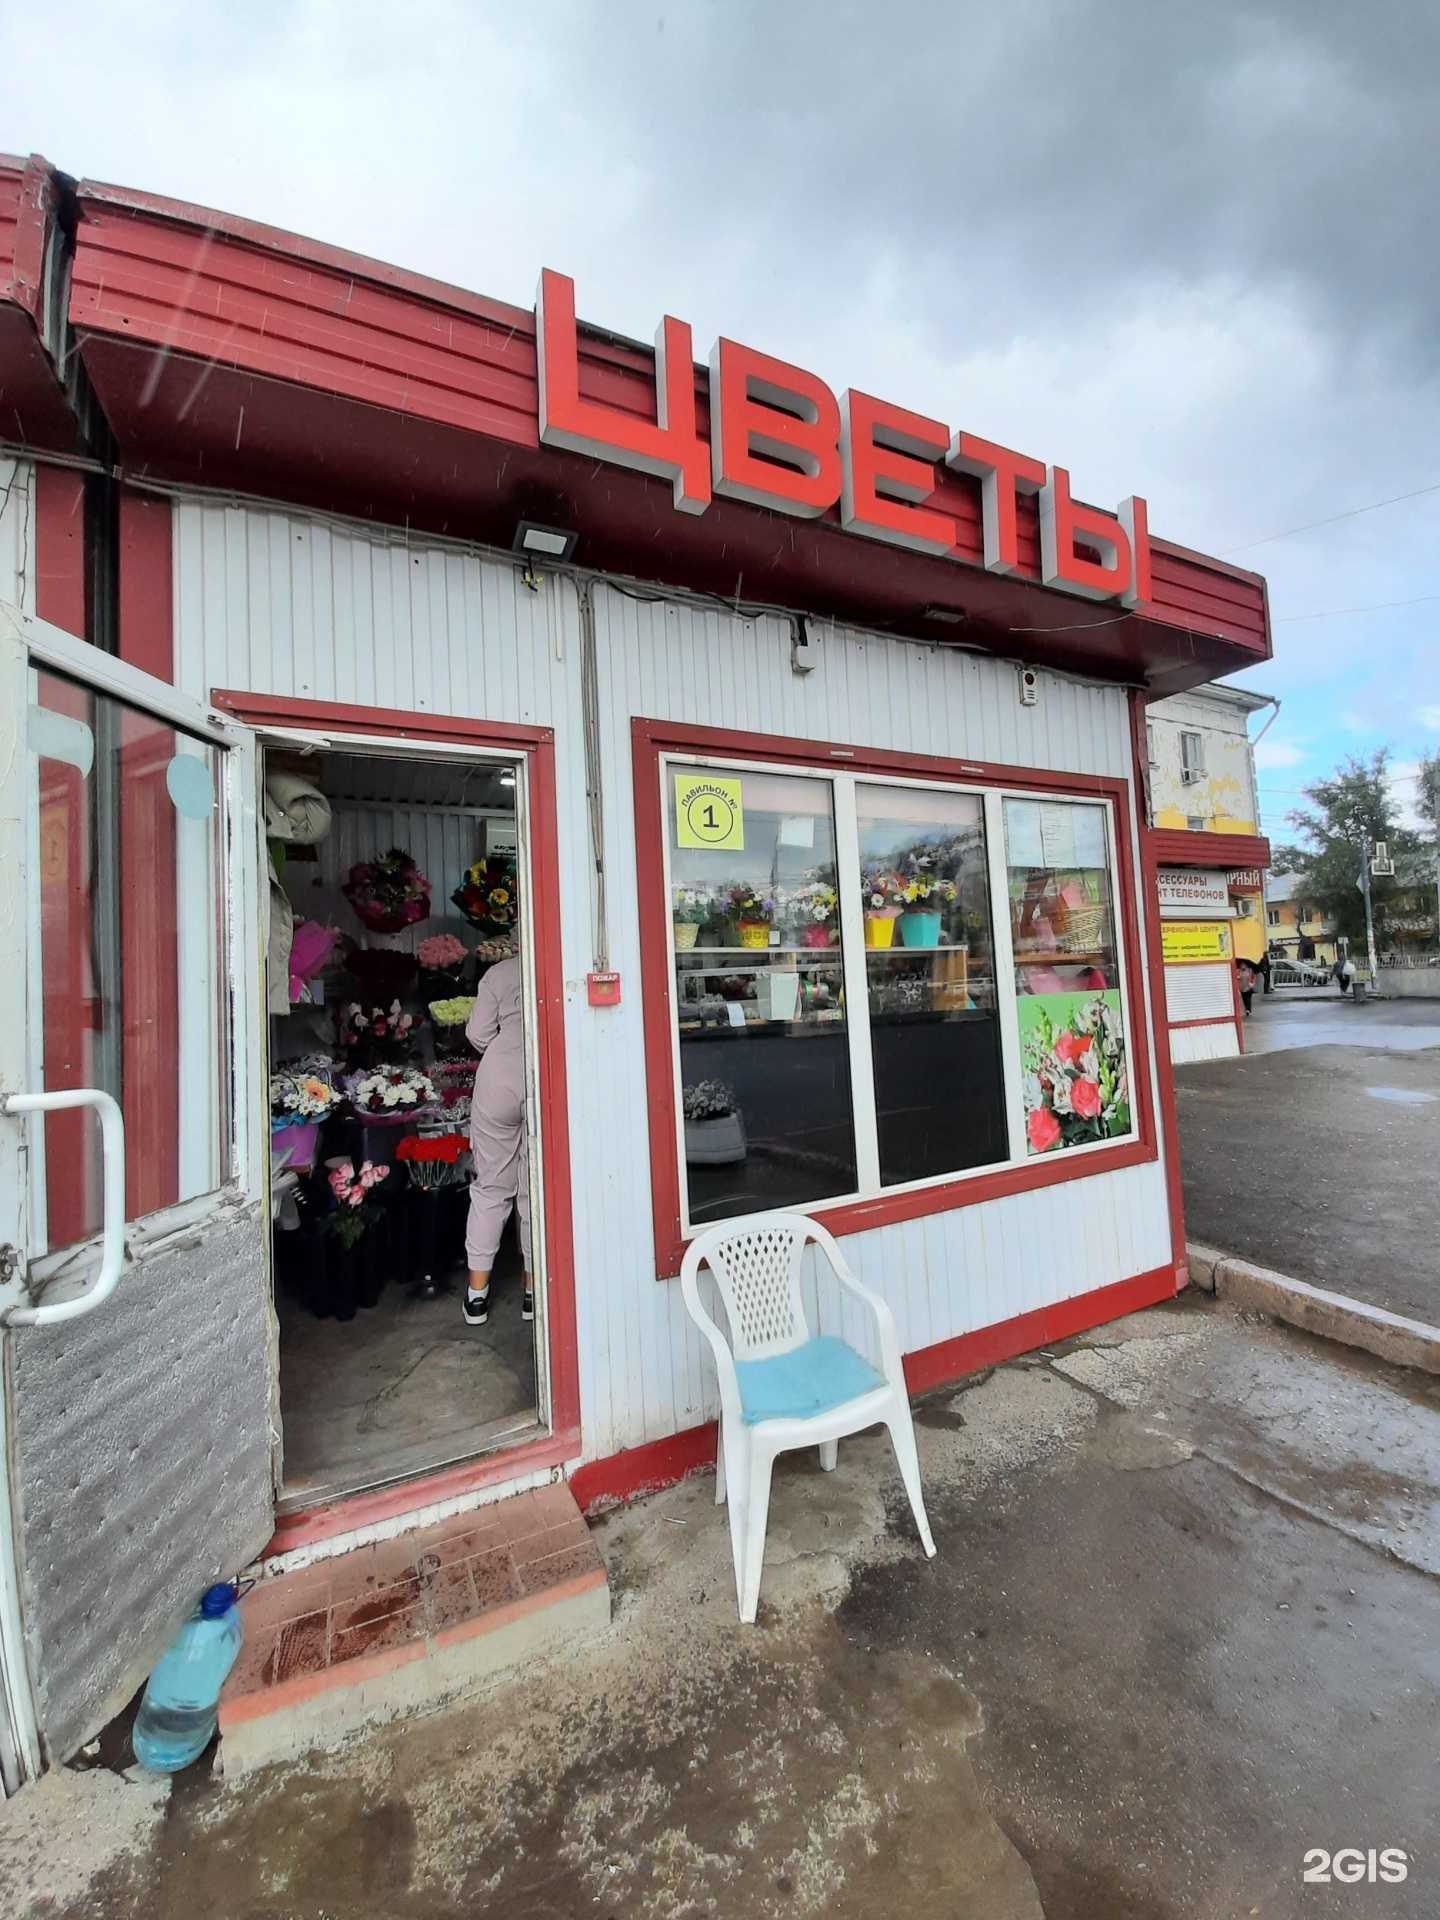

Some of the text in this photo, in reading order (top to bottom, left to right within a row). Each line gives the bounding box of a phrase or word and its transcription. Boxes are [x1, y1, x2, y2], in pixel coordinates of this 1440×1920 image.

[537, 267, 1152, 609] ЦВЕТЫ
[681, 784, 728, 807] ПАВИЛЬОН
[703, 805, 720, 828] 1
[1171, 888, 1225, 900] ТЕЛЕФОНОВ
